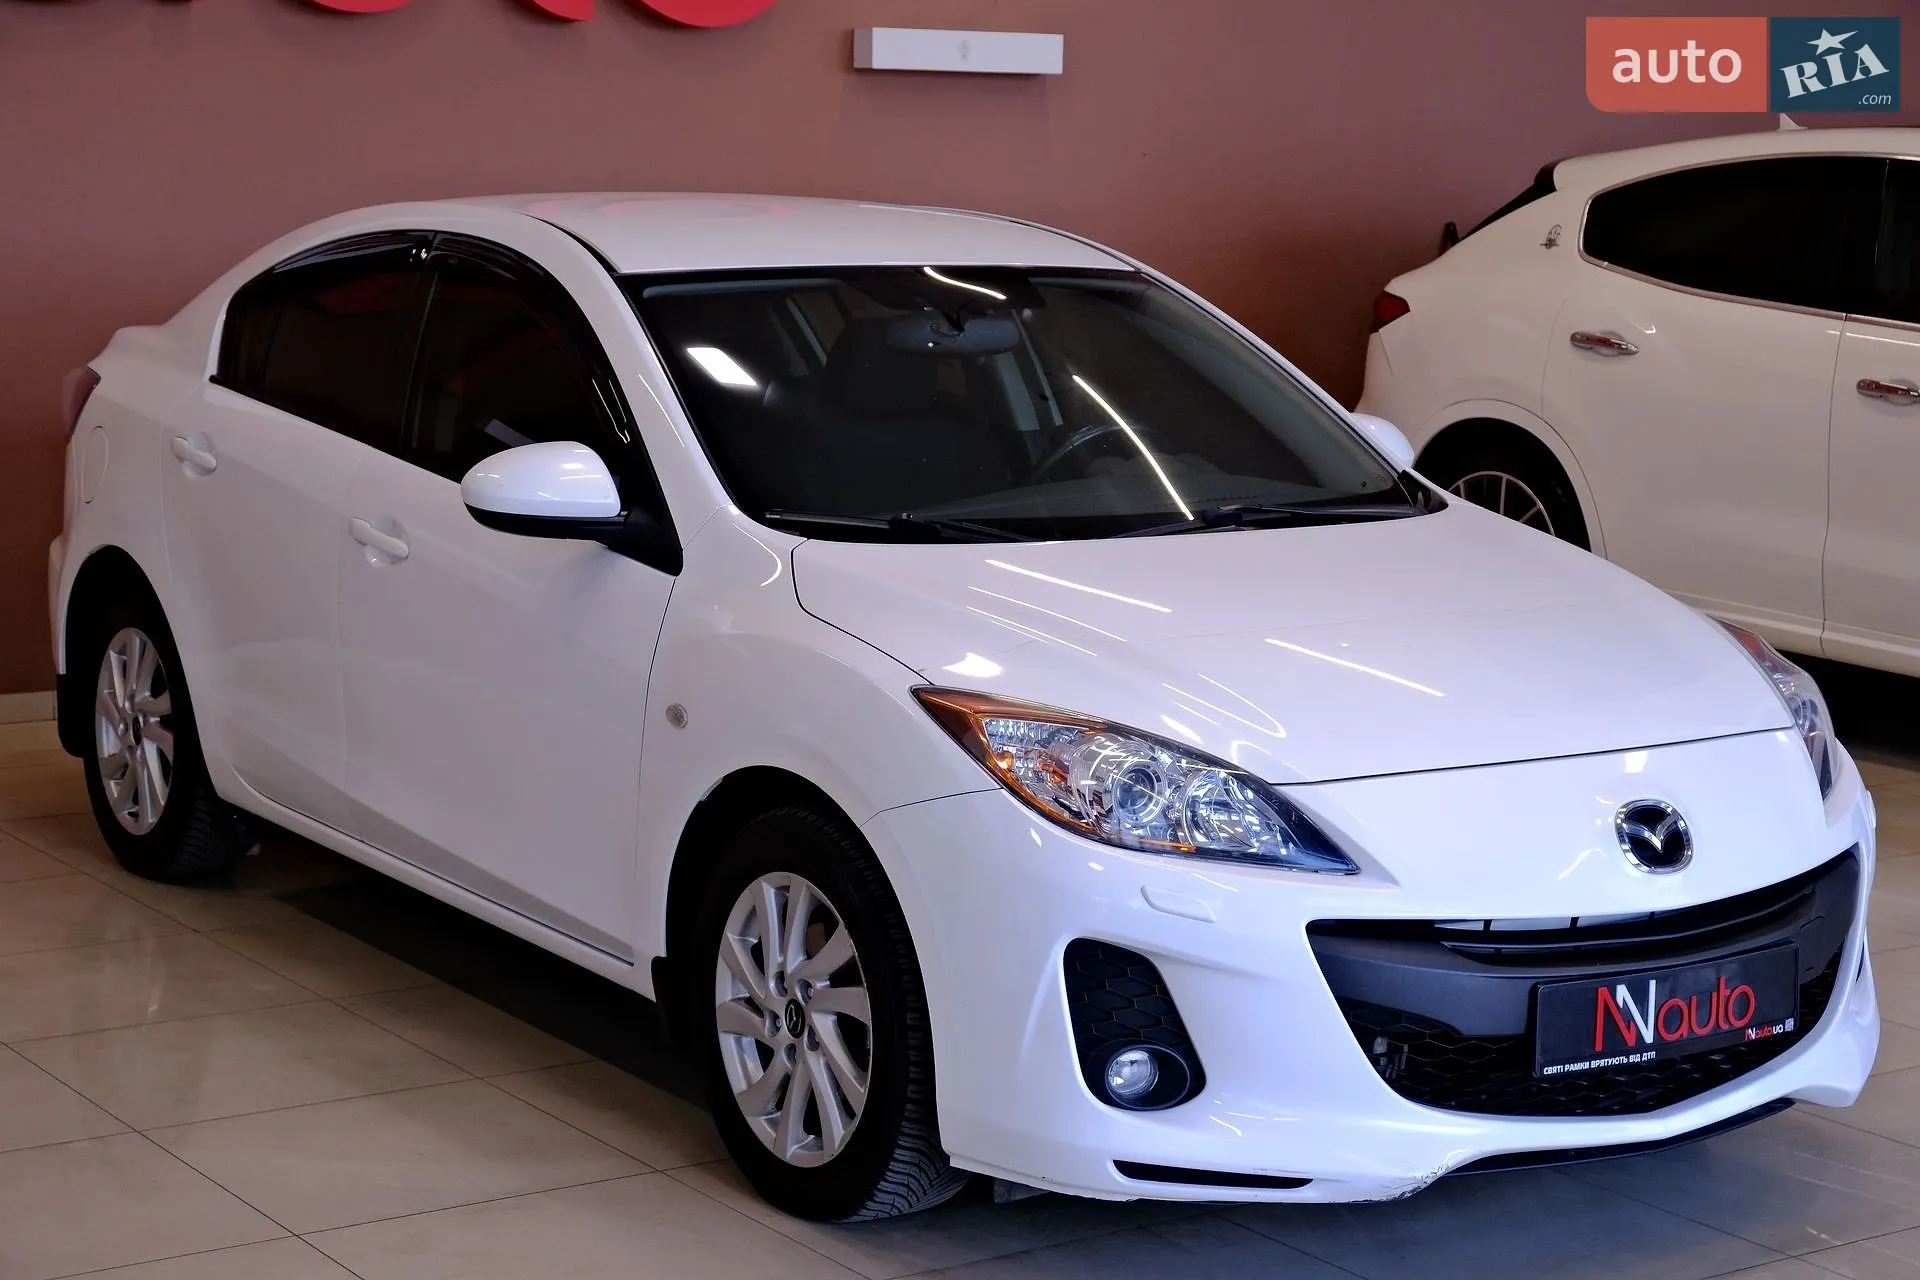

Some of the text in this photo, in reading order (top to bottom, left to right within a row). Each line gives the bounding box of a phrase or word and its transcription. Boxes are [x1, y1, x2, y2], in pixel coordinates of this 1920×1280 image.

[1543, 1051, 1656, 1075] СВЯТІ РАМКИ ВРЯТУЮТЬ ВІД ДТП
